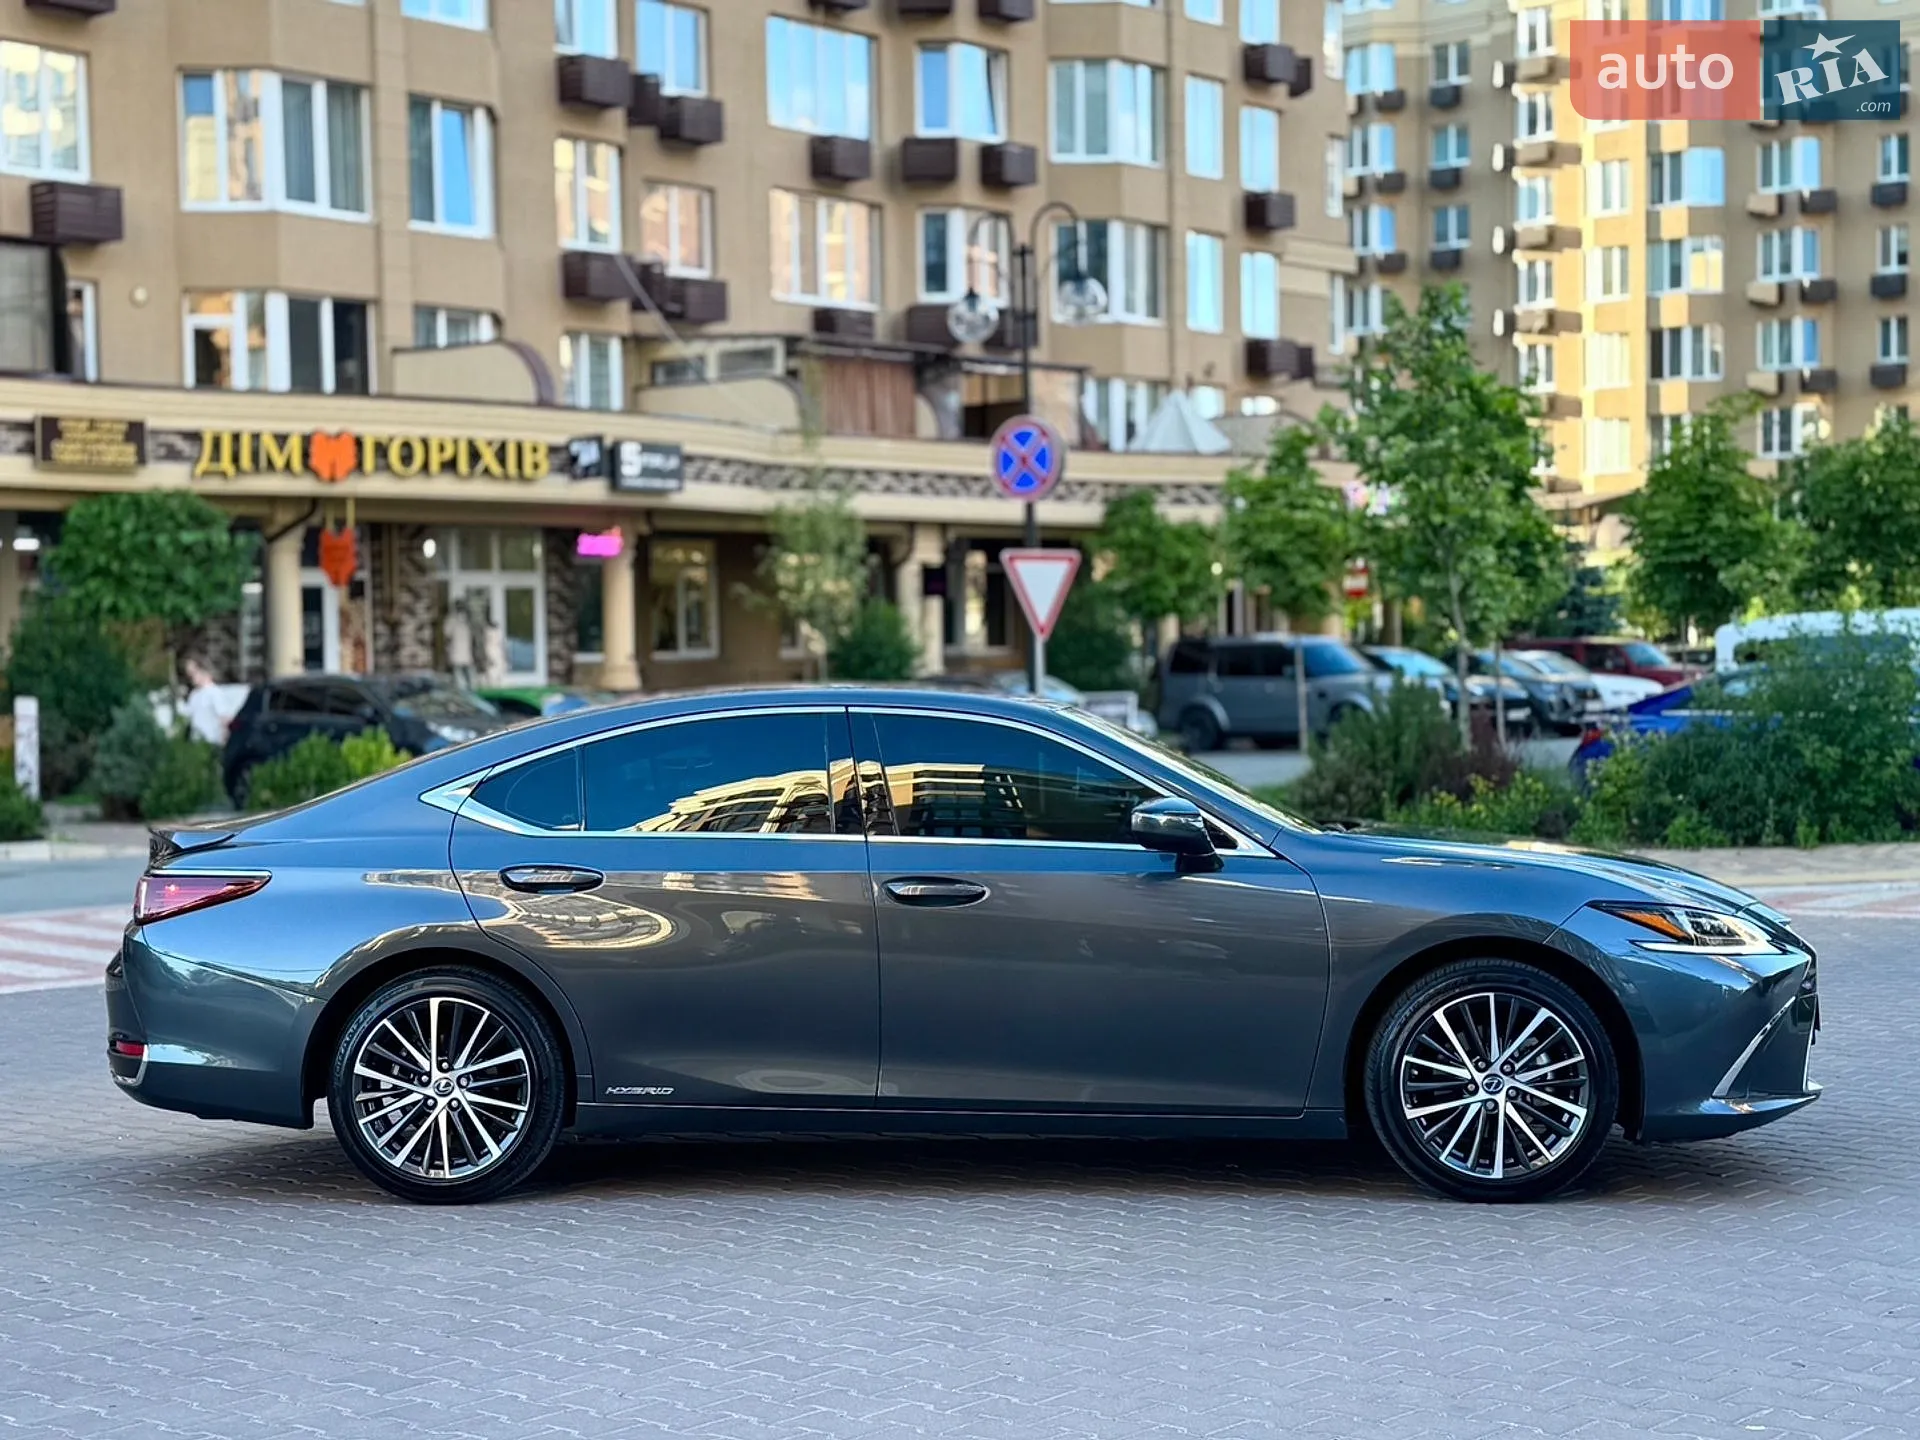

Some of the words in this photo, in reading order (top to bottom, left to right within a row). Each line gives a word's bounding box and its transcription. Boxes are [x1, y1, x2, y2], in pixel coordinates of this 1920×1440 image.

[194, 429, 304, 479] ДІМ
[361, 433, 550, 480] ГОРІХІВ
[605, 1086, 675, 1095] HYBRID
